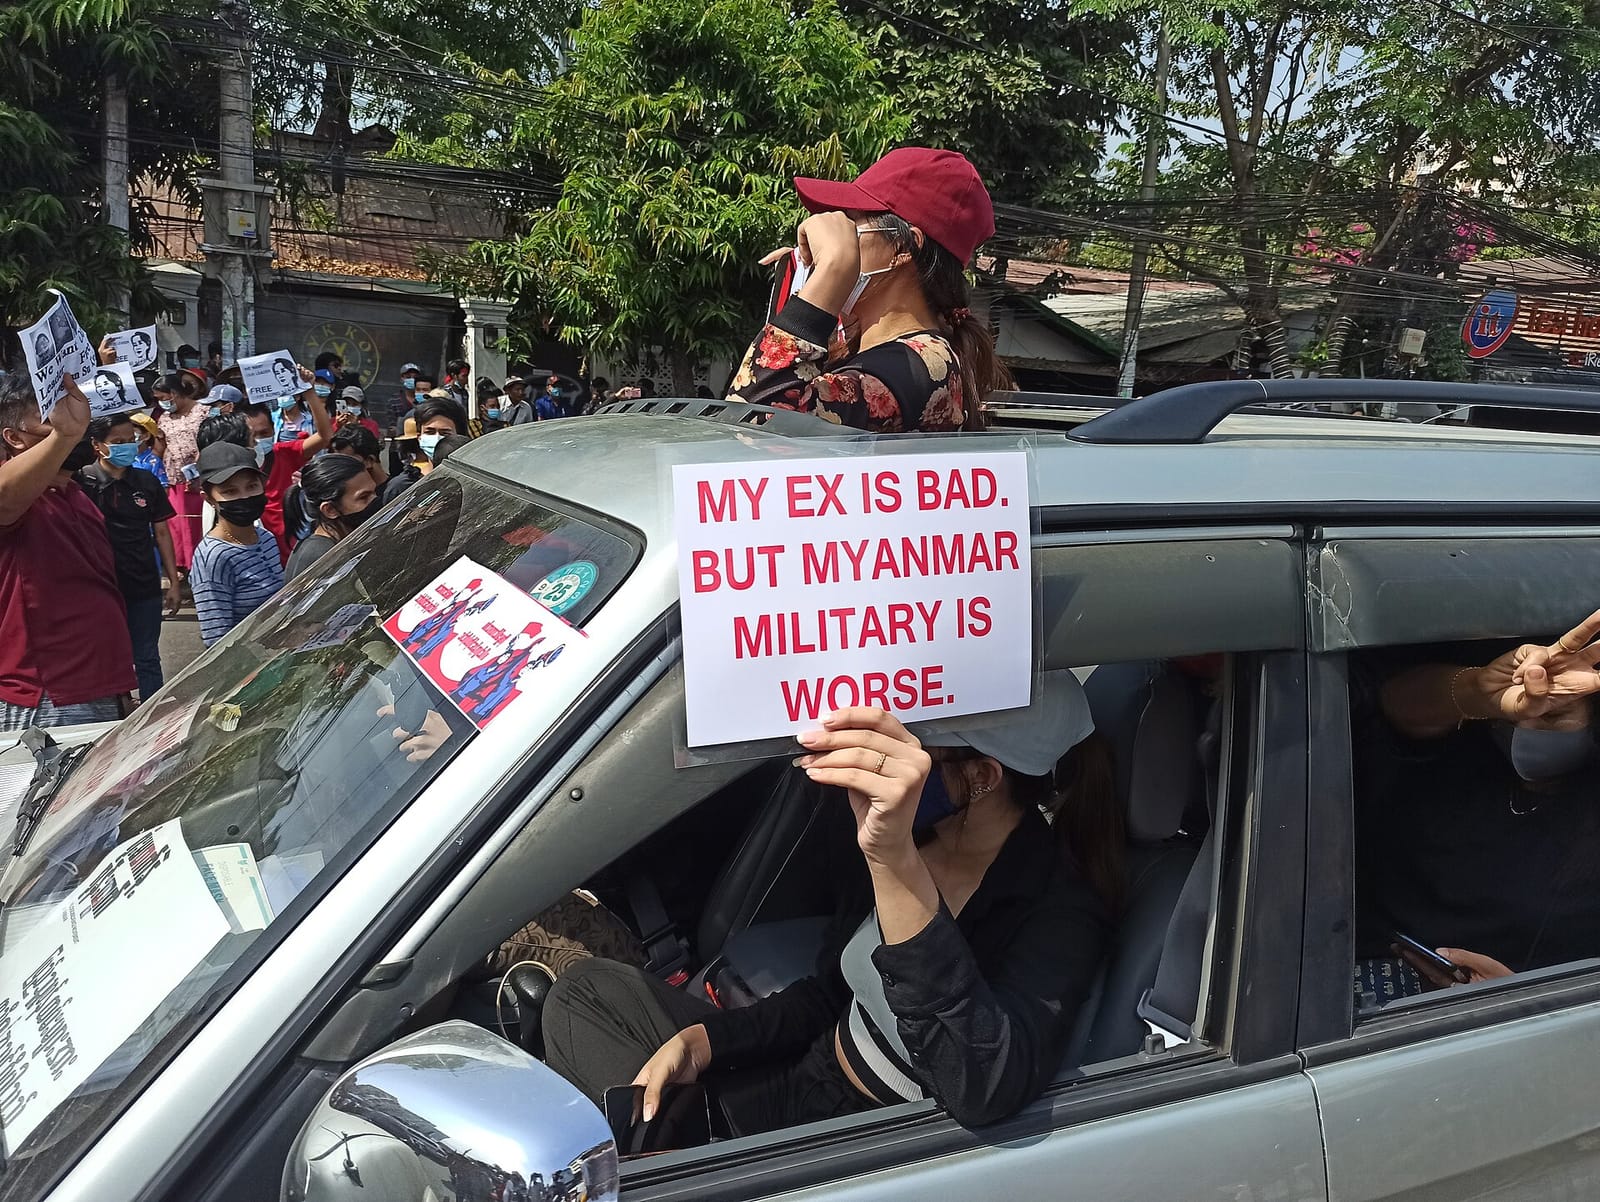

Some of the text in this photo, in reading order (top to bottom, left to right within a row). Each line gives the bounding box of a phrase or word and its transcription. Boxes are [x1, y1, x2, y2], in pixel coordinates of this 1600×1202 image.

[35, 366, 54, 383] We
[250, 385, 273, 396] FREE
[697, 467, 1009, 524] MY EX IS BAD.
[692, 530, 1020, 594] BUT MYANMAR
[733, 596, 992, 660] MILITARY IS
[780, 665, 955, 723] WORSE.
